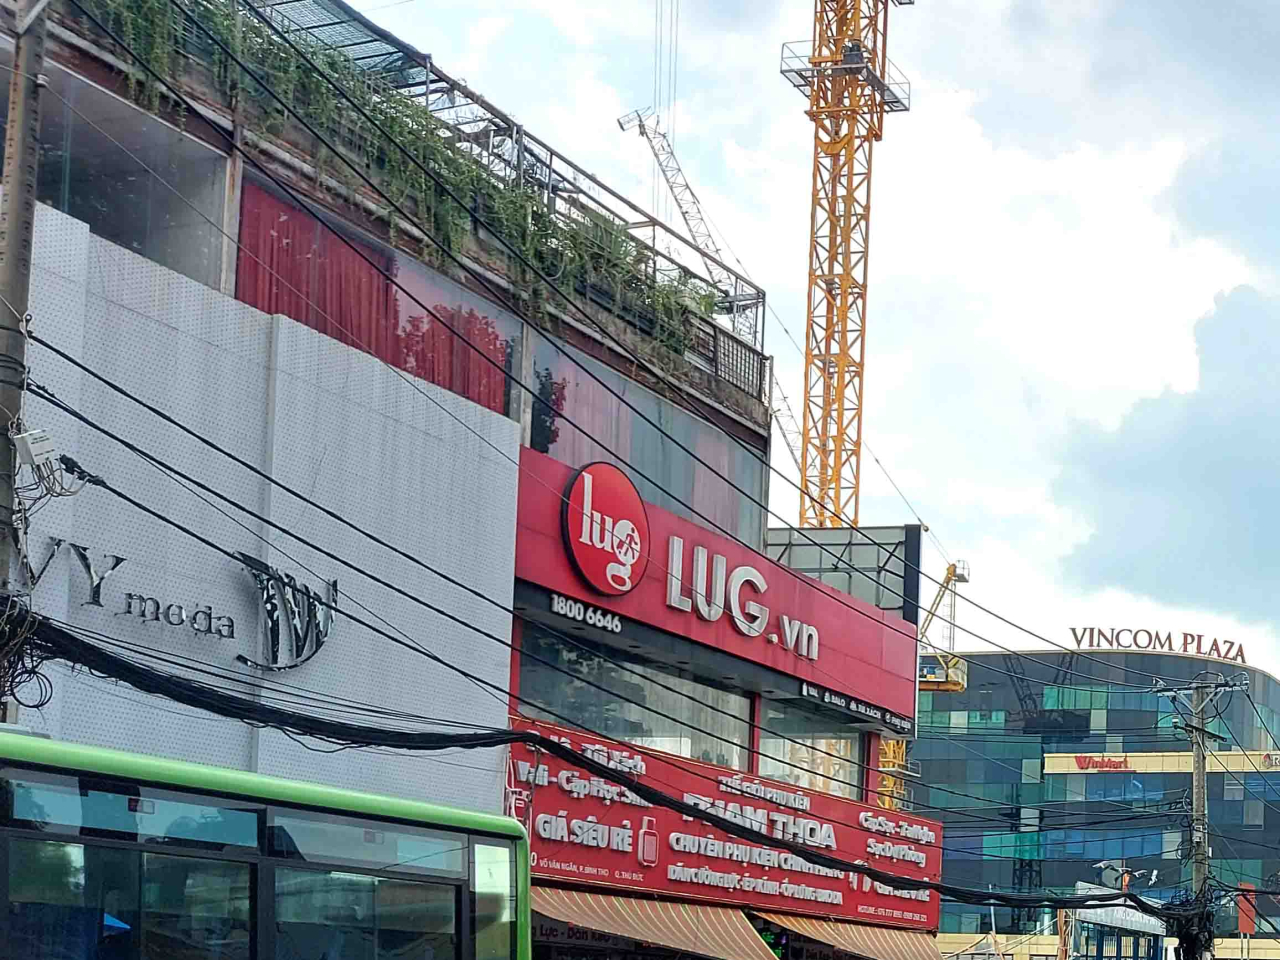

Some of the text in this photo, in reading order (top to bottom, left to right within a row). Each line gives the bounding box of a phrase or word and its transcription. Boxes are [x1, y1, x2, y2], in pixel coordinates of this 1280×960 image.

[579, 471, 642, 591] lug
[117, 591, 235, 639] moda
[551, 594, 622, 633] 1800 6646
[666, 536, 819, 661] LUG.vn
[1069, 627, 1246, 664] VINCOM PLAZA
[535, 810, 633, 852] GIÁ SIÊU RẺ
[769, 812, 837, 850] THOA
[669, 832, 724, 858] CHUYÊN
[724, 841, 751, 867] PHỤ
[750, 846, 779, 871] KIỆN
